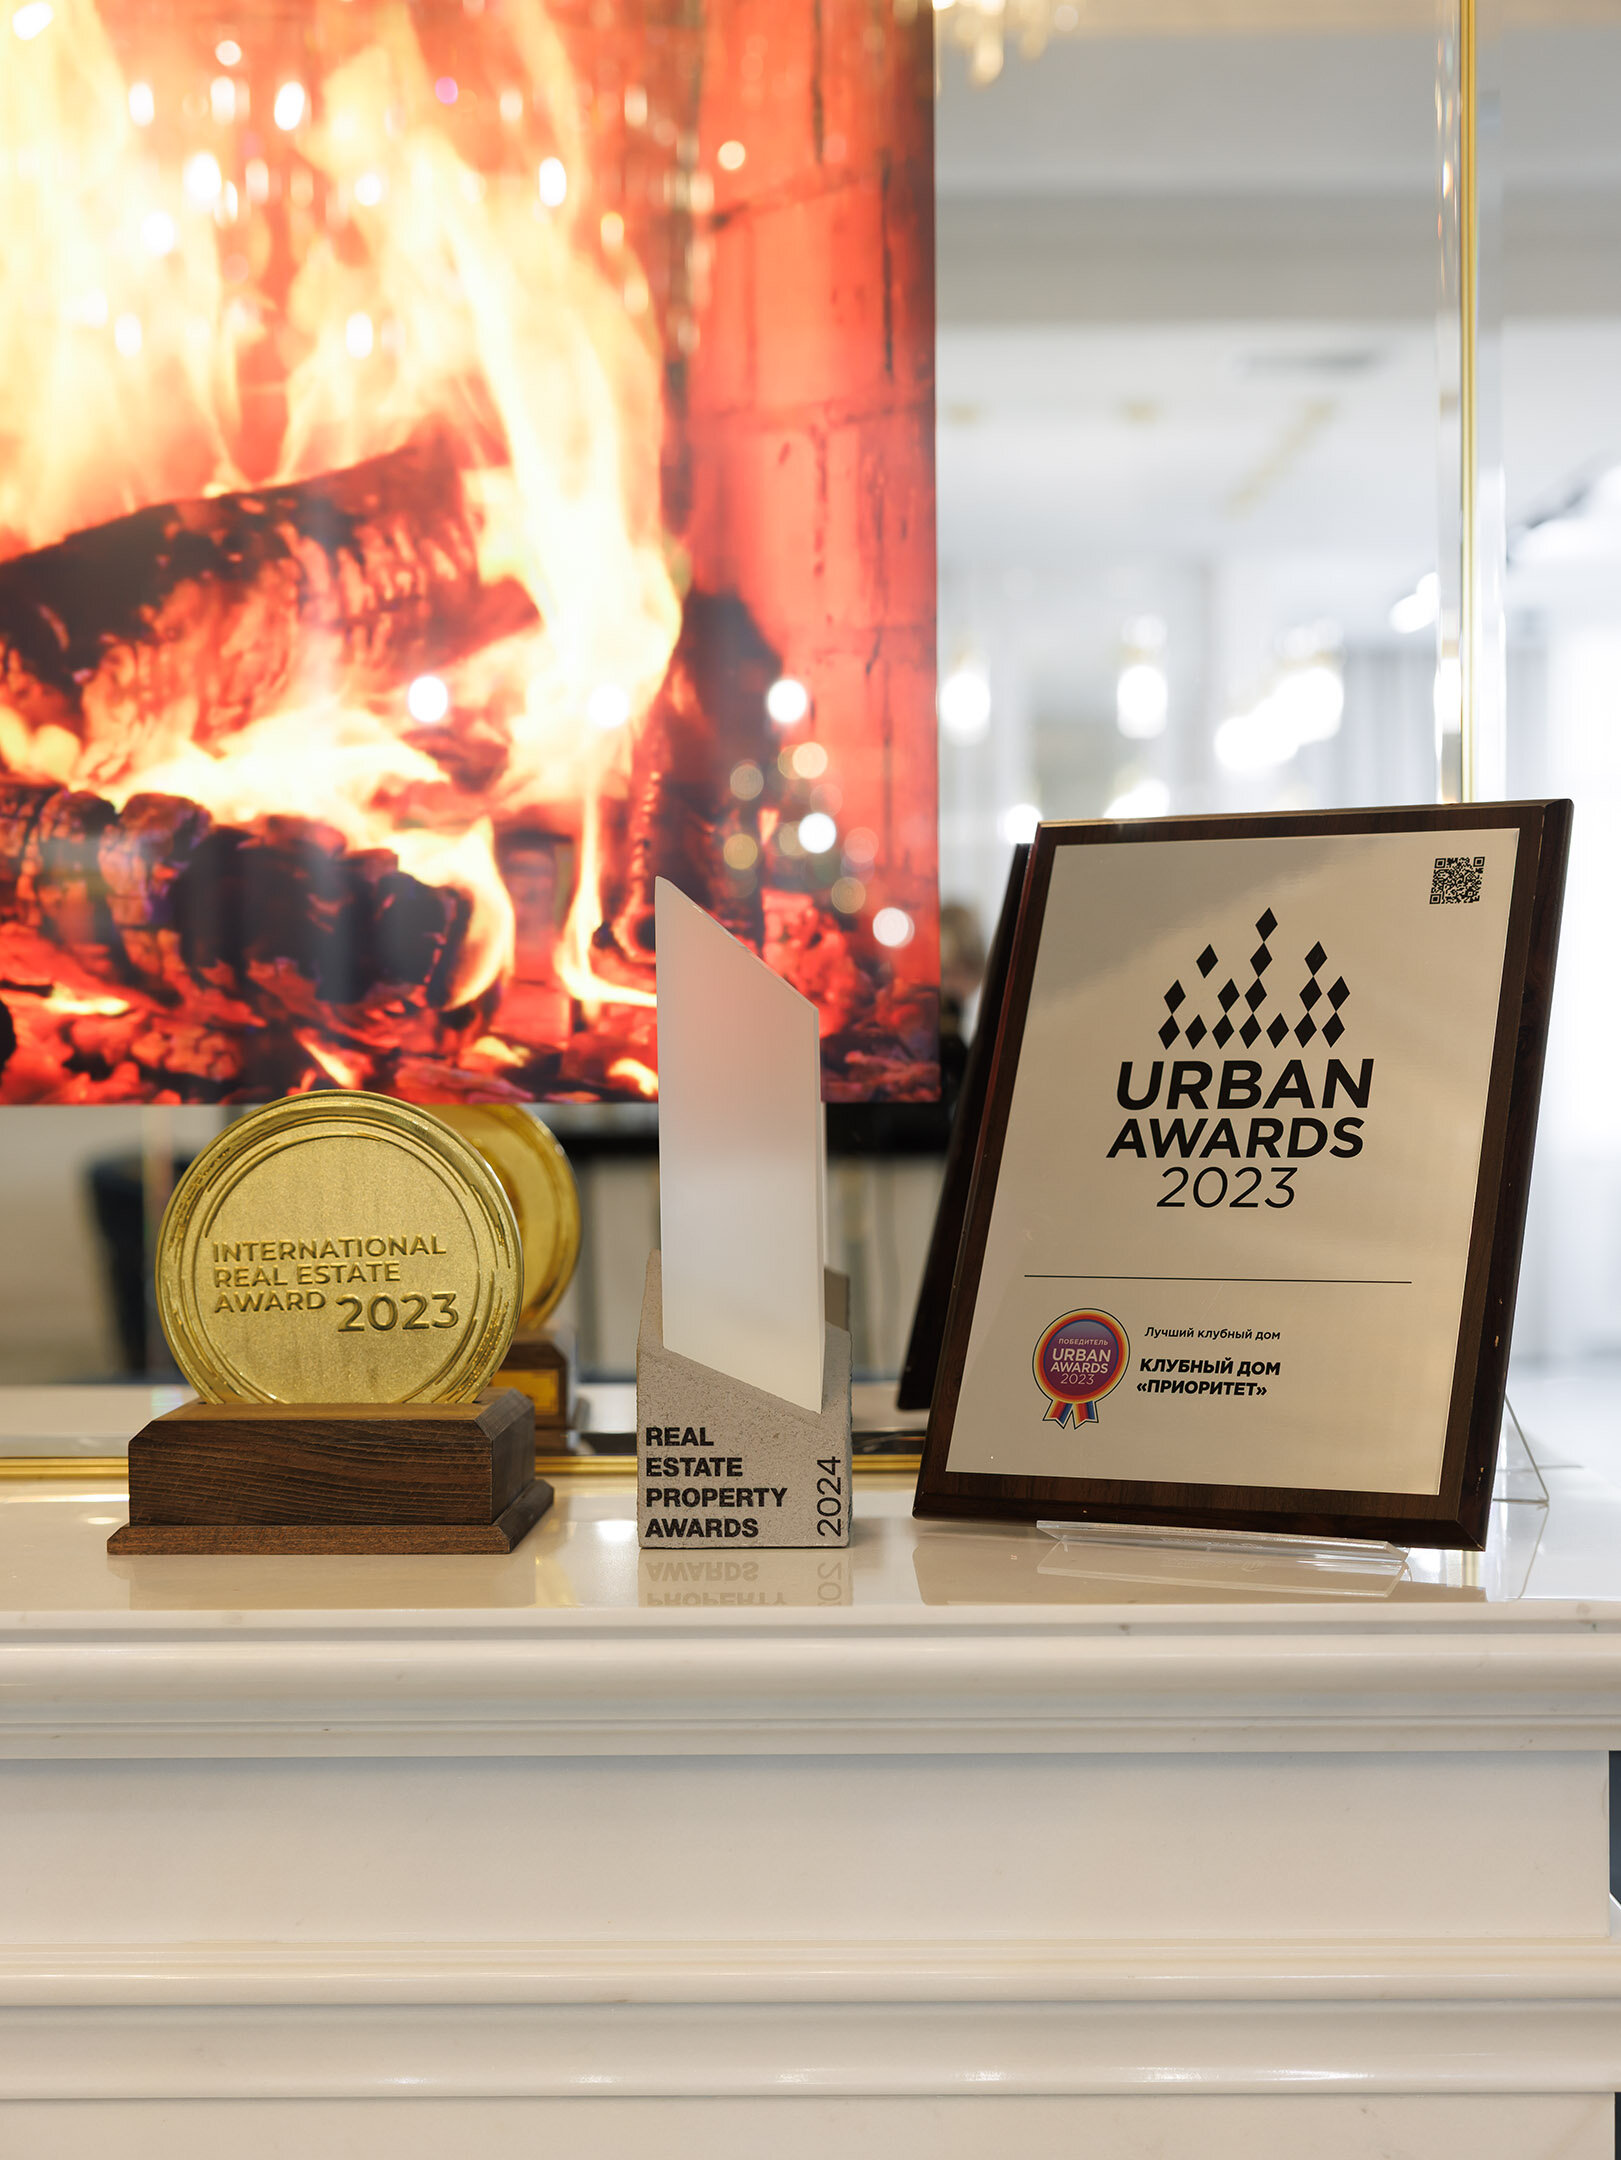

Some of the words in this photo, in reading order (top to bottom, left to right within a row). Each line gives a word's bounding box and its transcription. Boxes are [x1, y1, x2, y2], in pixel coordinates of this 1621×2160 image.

[1116, 1058, 1374, 1111] URBAN
[1105, 1117, 1365, 1159] AWARDS
[1156, 1166, 1298, 1209] 2023
[212, 1234, 447, 1263] INTERNATIONAL
[214, 1264, 288, 1288] REAL
[296, 1261, 401, 1286] ESTATE
[214, 1288, 327, 1314] AWARD
[336, 1290, 460, 1333] 2023
[1058, 1338, 1109, 1346] ПОБЕДИТЕЛЬ
[1144, 1326, 1195, 1339] Лучший
[1197, 1328, 1253, 1341] клубный
[1254, 1331, 1281, 1341] дом
[1052, 1347, 1111, 1363] URBAN
[1050, 1361, 1109, 1374] AWARDS
[1139, 1357, 1234, 1375] КЛУБНЫЙ
[1236, 1361, 1281, 1377] ДОМ
[1060, 1373, 1095, 1385] 2023
[1136, 1379, 1268, 1396] «ПРИОРИТЕТ»
[645, 1427, 715, 1446] REAL
[646, 1457, 743, 1477] ESTATE
[646, 1487, 788, 1507] PROPERTY
[816, 1455, 842, 1537] 2024
[645, 1518, 759, 1538] AWARDS
